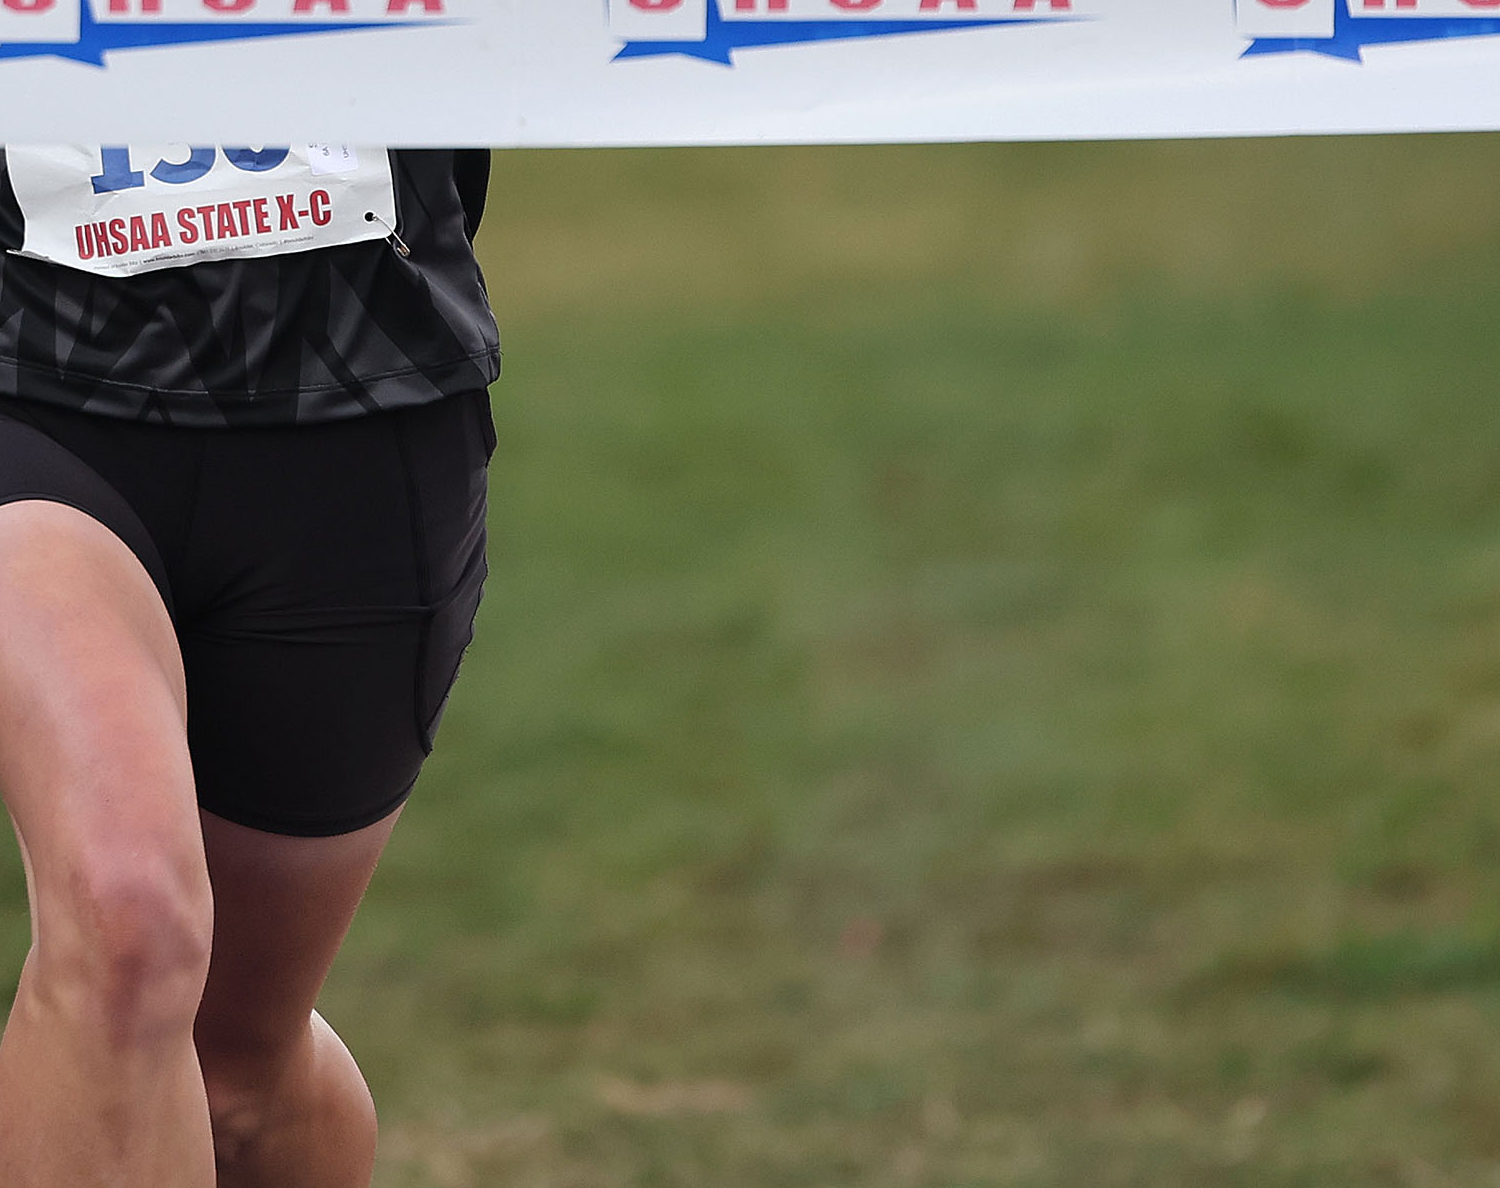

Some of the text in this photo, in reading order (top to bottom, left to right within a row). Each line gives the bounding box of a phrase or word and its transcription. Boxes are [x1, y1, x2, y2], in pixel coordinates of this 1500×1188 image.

[75, 213, 172, 260] UHSAA
[176, 198, 272, 244] STATE
[275, 189, 332, 232] X-C
